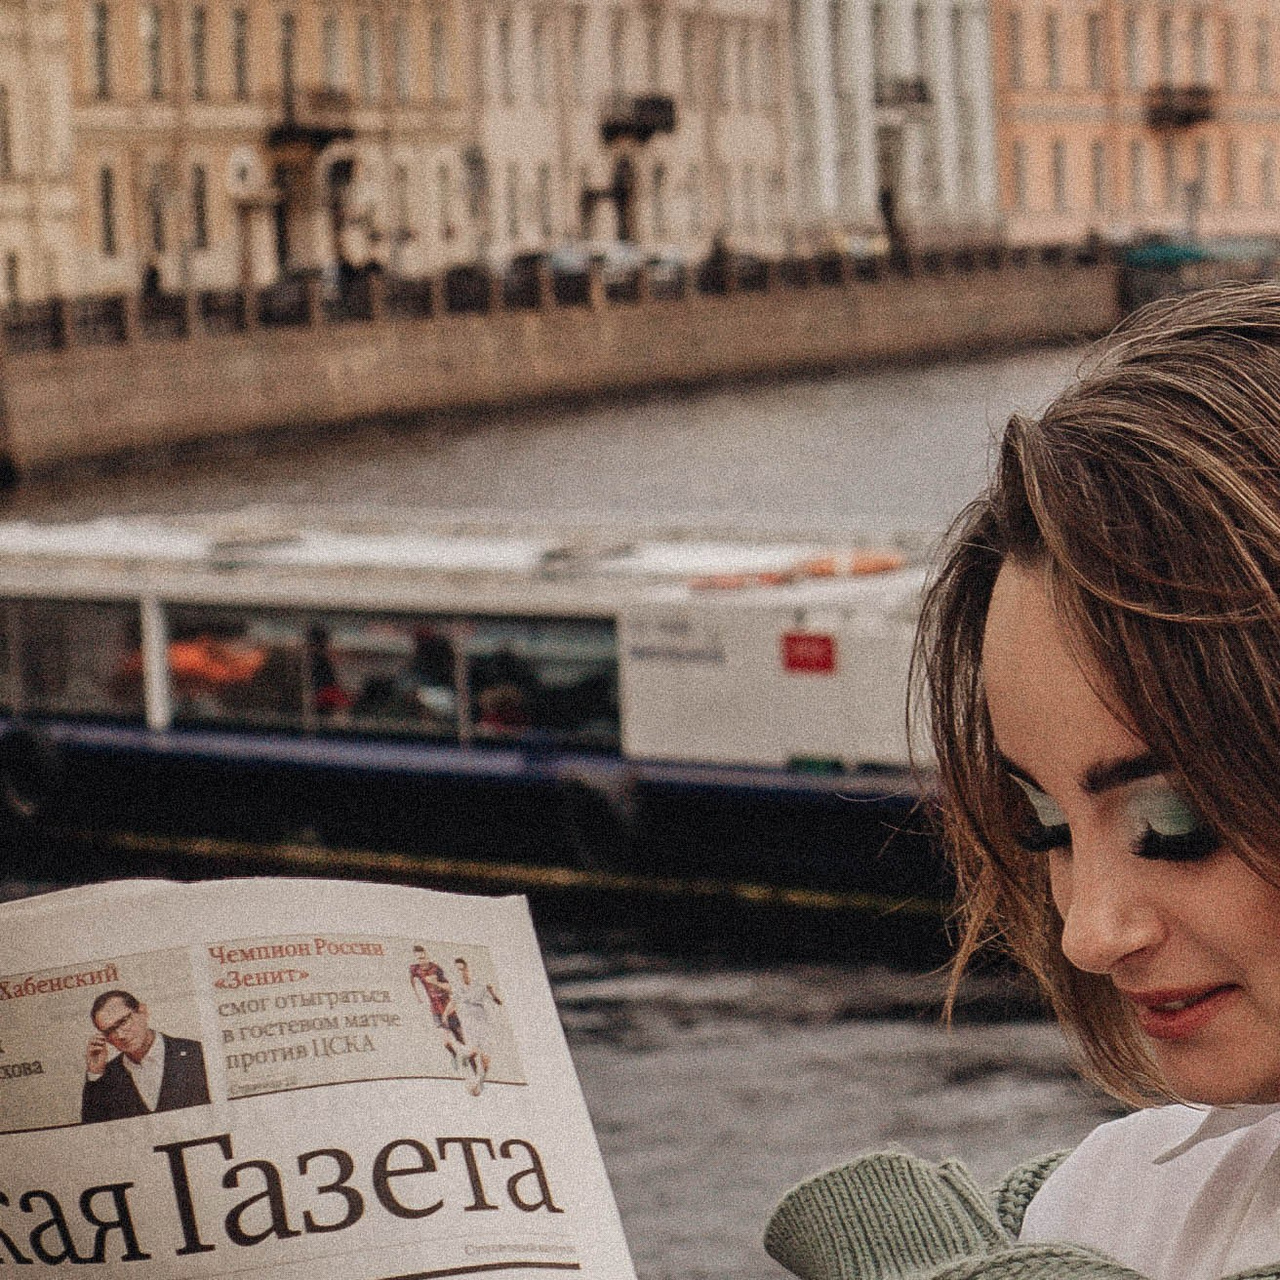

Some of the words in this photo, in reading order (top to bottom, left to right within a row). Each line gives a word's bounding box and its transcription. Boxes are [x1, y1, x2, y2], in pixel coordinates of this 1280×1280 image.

[208, 941, 311, 966] Чемпион
[313, 937, 386, 957] России
[217, 997, 270, 1018] смог
[274, 989, 393, 1010] отыграться
[221, 1029, 235, 1045] в
[239, 1014, 339, 1042] гостевом
[344, 1012, 401, 1029] матче
[225, 1043, 309, 1073] против
[312, 1034, 377, 1060] ЦСКА
[152, 1133, 565, 1257] Газета
